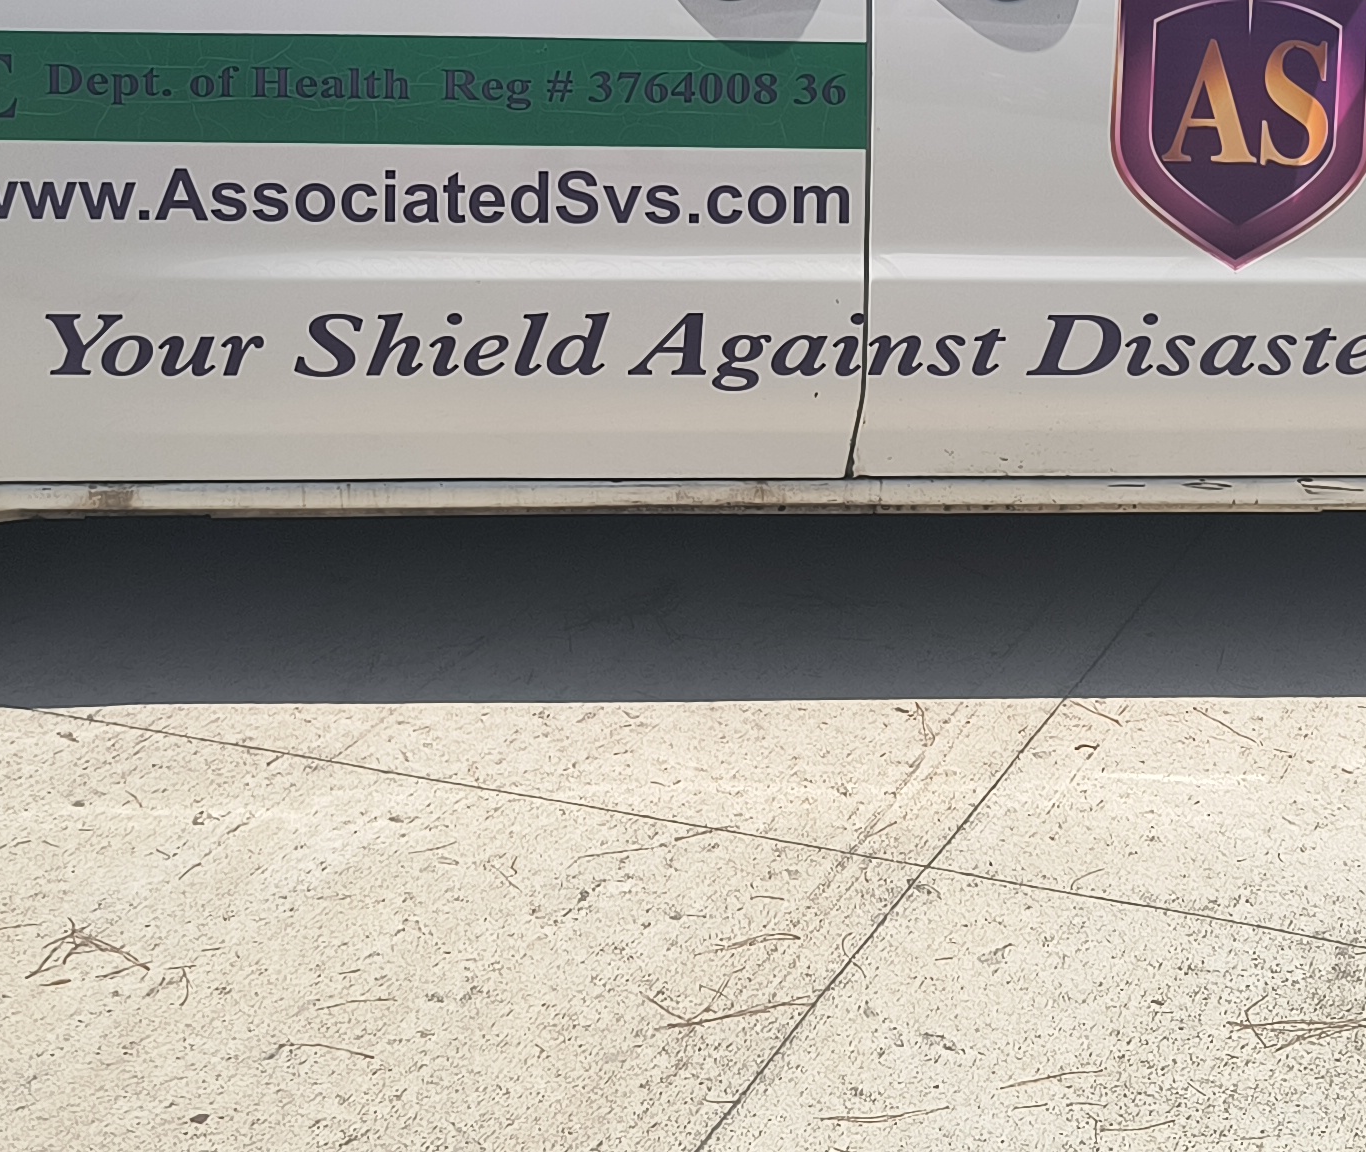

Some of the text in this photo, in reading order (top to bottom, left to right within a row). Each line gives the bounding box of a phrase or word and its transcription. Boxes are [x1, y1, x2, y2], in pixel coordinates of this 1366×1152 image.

[46, 61, 848, 110] Dept. of Health Reg # 3764008 36
[1161, 38, 1330, 166] AS
[45, 313, 265, 378] Your
[294, 311, 612, 379] Shield
[627, 311, 1006, 392] Against
